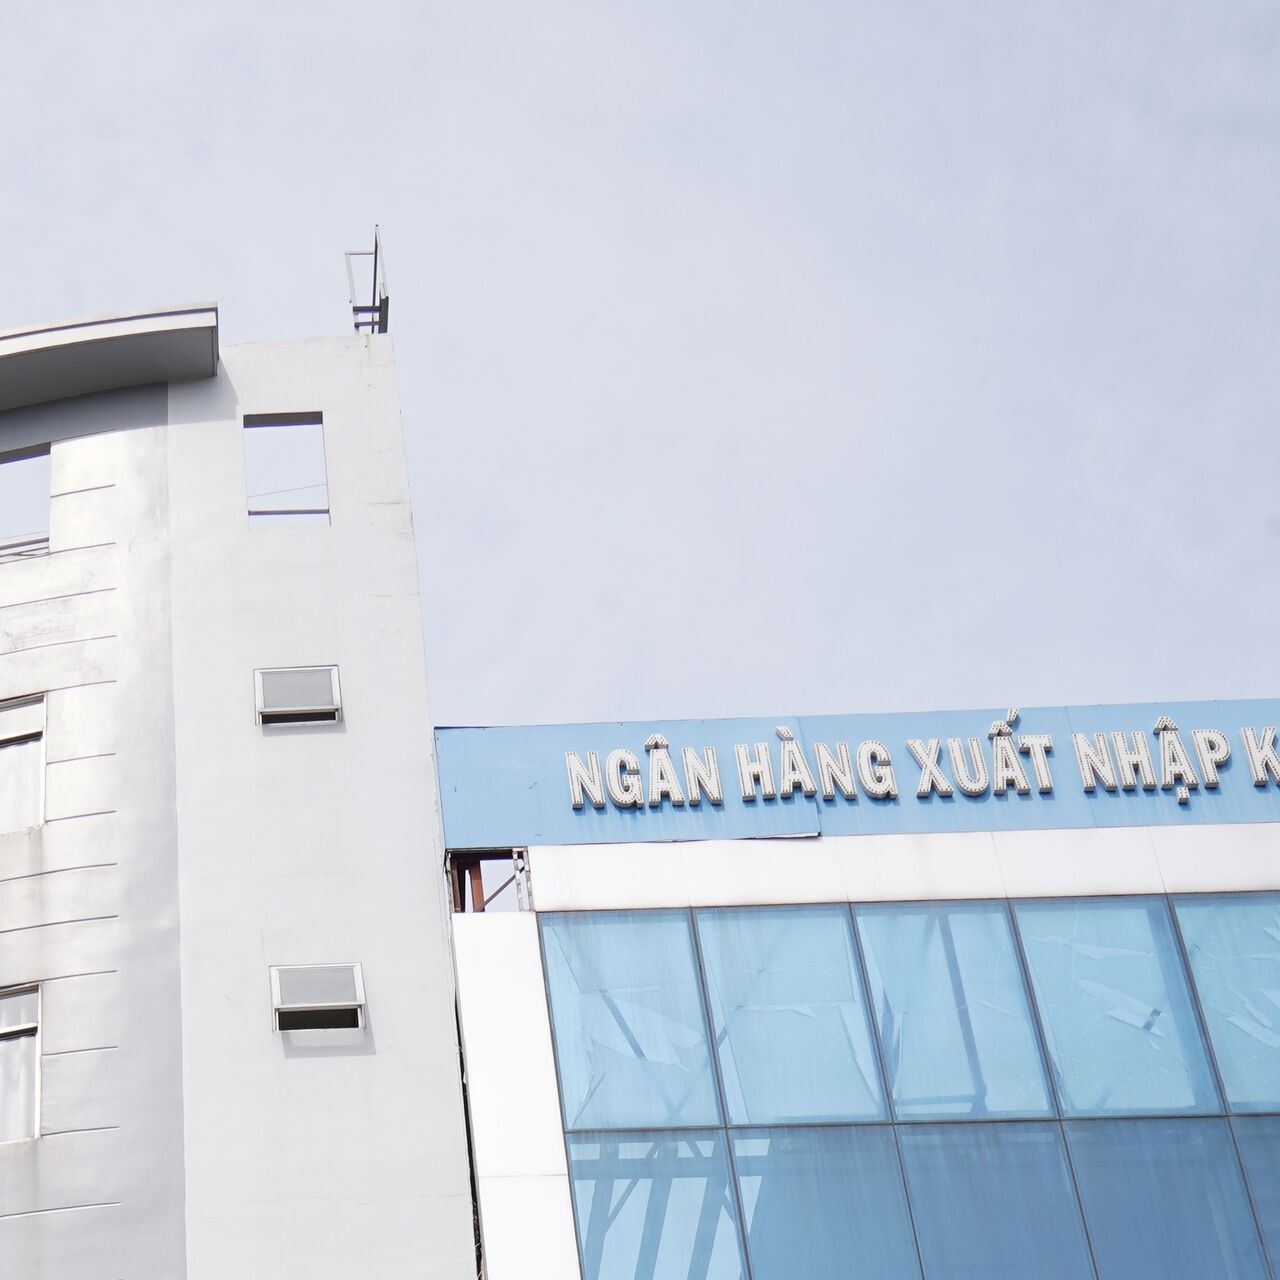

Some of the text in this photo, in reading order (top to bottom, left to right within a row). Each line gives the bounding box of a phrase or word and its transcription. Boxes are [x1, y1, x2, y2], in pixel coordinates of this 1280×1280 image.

[564, 733, 723, 809] NGÂN
[733, 726, 899, 803] HÀNG
[907, 708, 1053, 797] XUẤT
[1072, 715, 1231, 805] NHẬP
